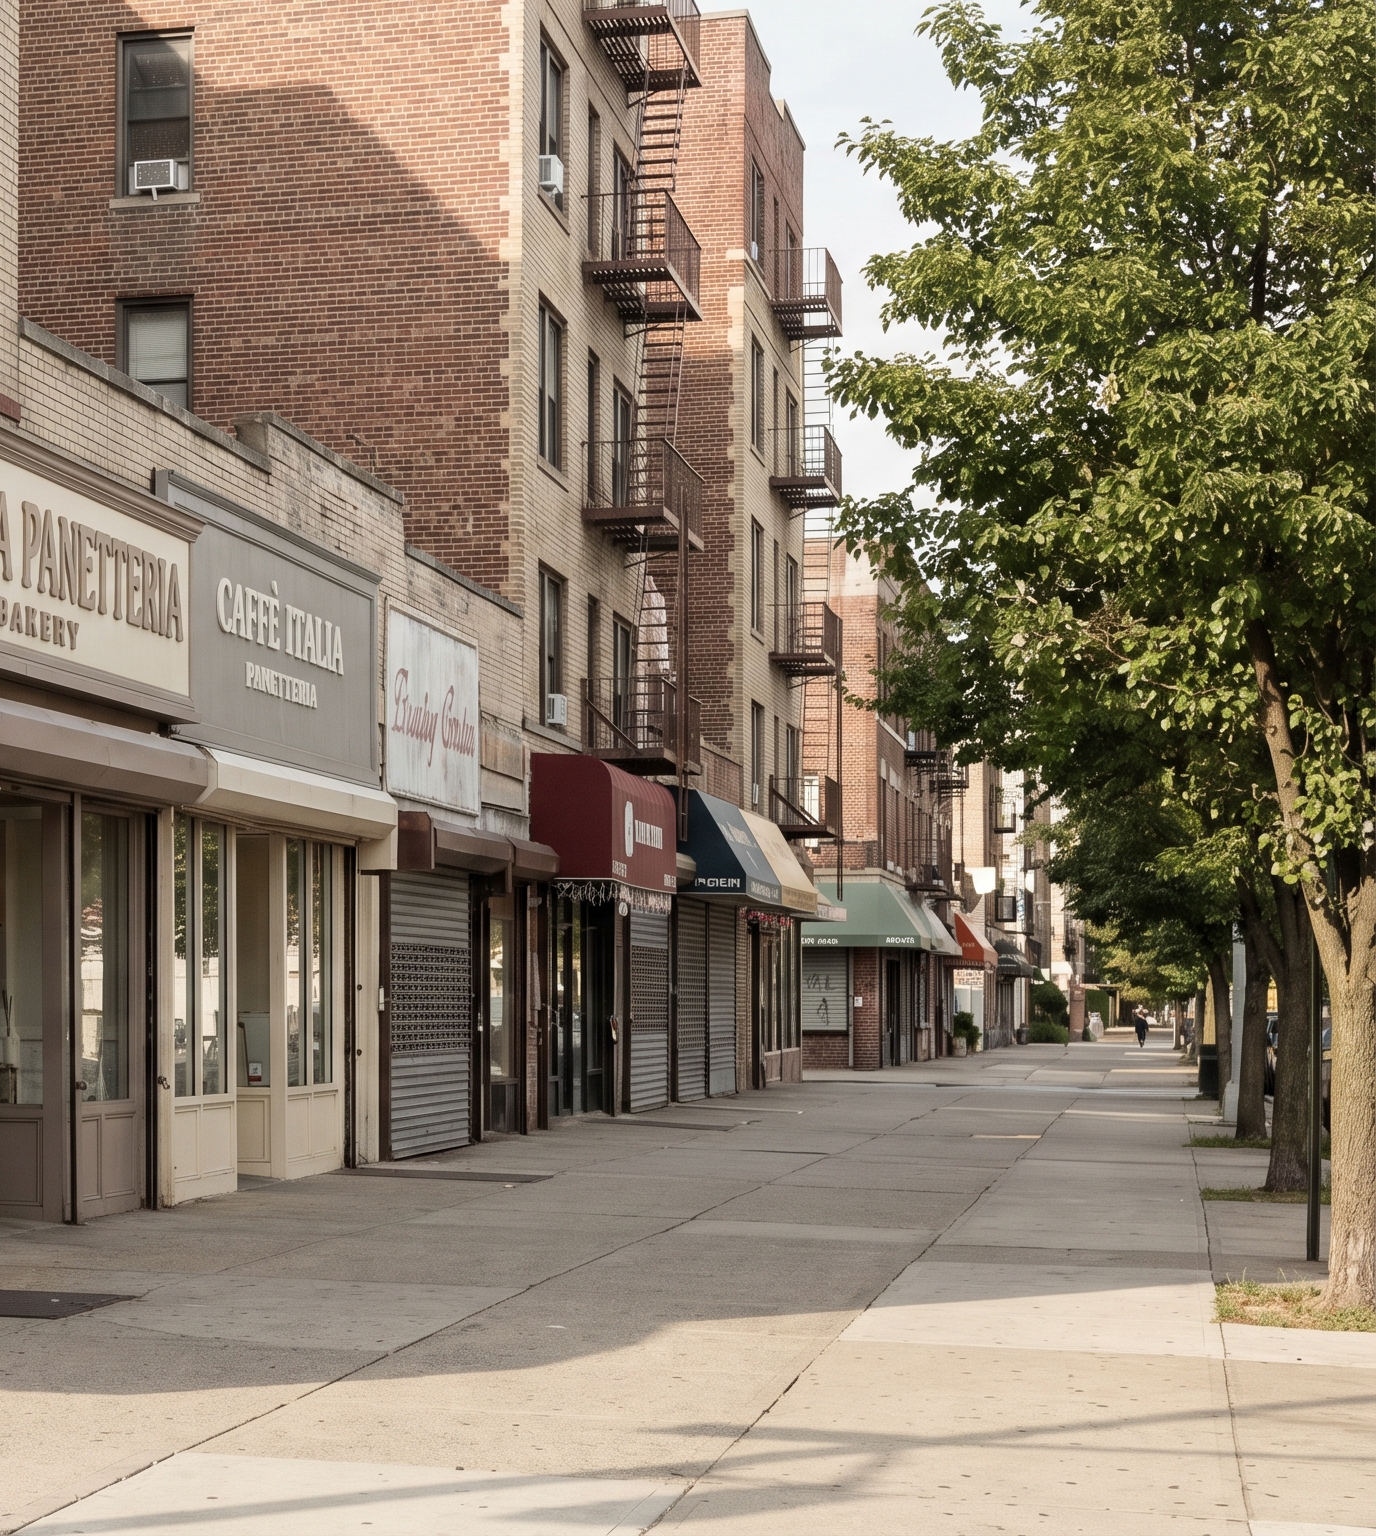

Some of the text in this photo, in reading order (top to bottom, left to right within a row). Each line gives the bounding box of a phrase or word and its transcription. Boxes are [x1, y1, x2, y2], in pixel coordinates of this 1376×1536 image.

[22, 500, 184, 642] PANETTERIA
[216, 577, 344, 676] CAFFÈ ITALIA
